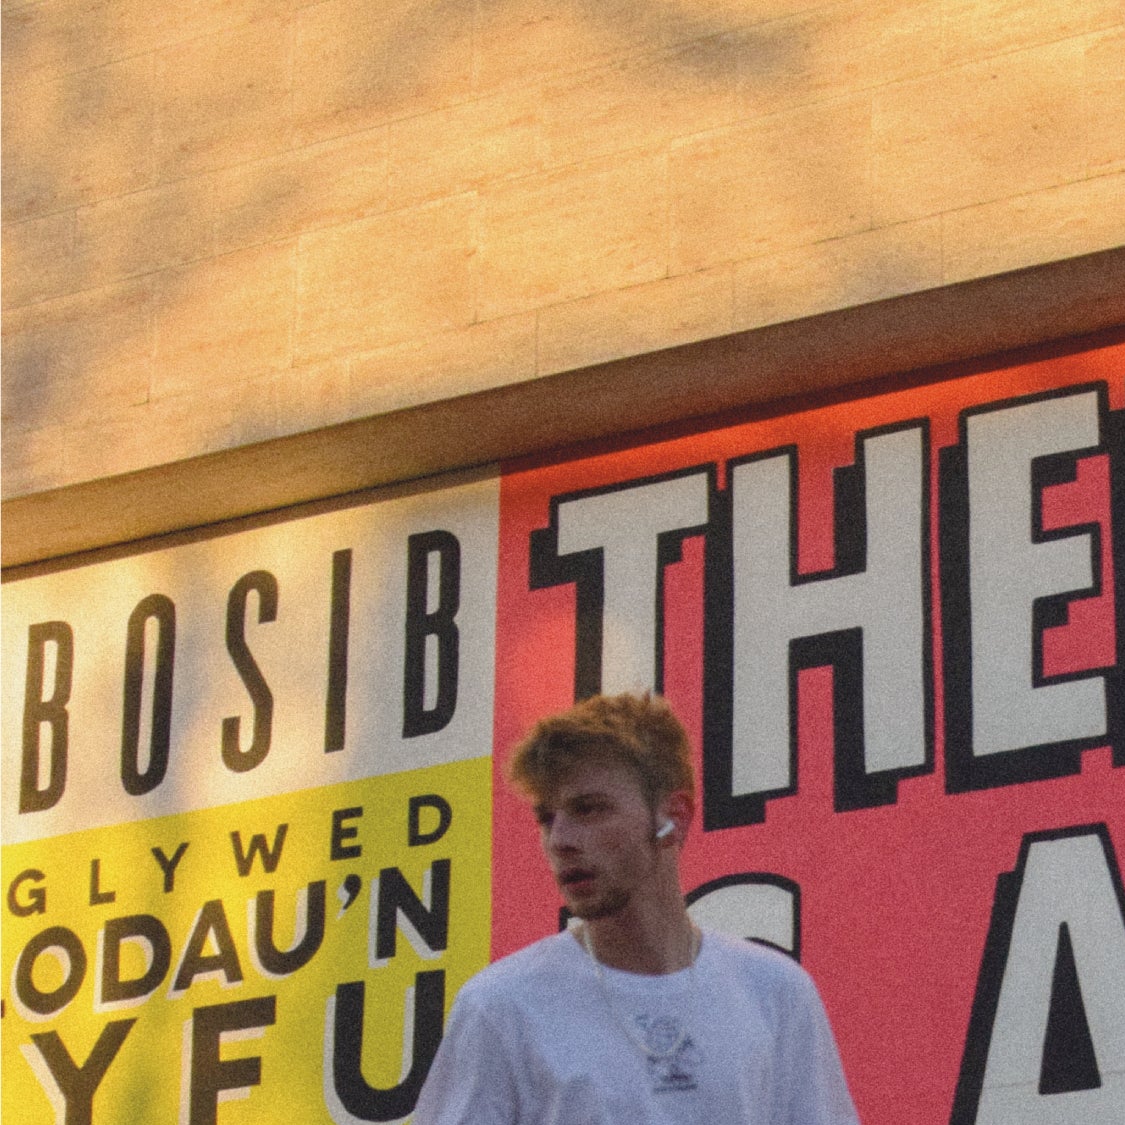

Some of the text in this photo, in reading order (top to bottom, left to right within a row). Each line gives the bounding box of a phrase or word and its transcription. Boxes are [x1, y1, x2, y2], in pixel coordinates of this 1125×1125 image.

[19, 529, 461, 815] BOSIB
[7, 794, 453, 918] GLYWED
[0, 858, 455, 1023] ODAU'N
